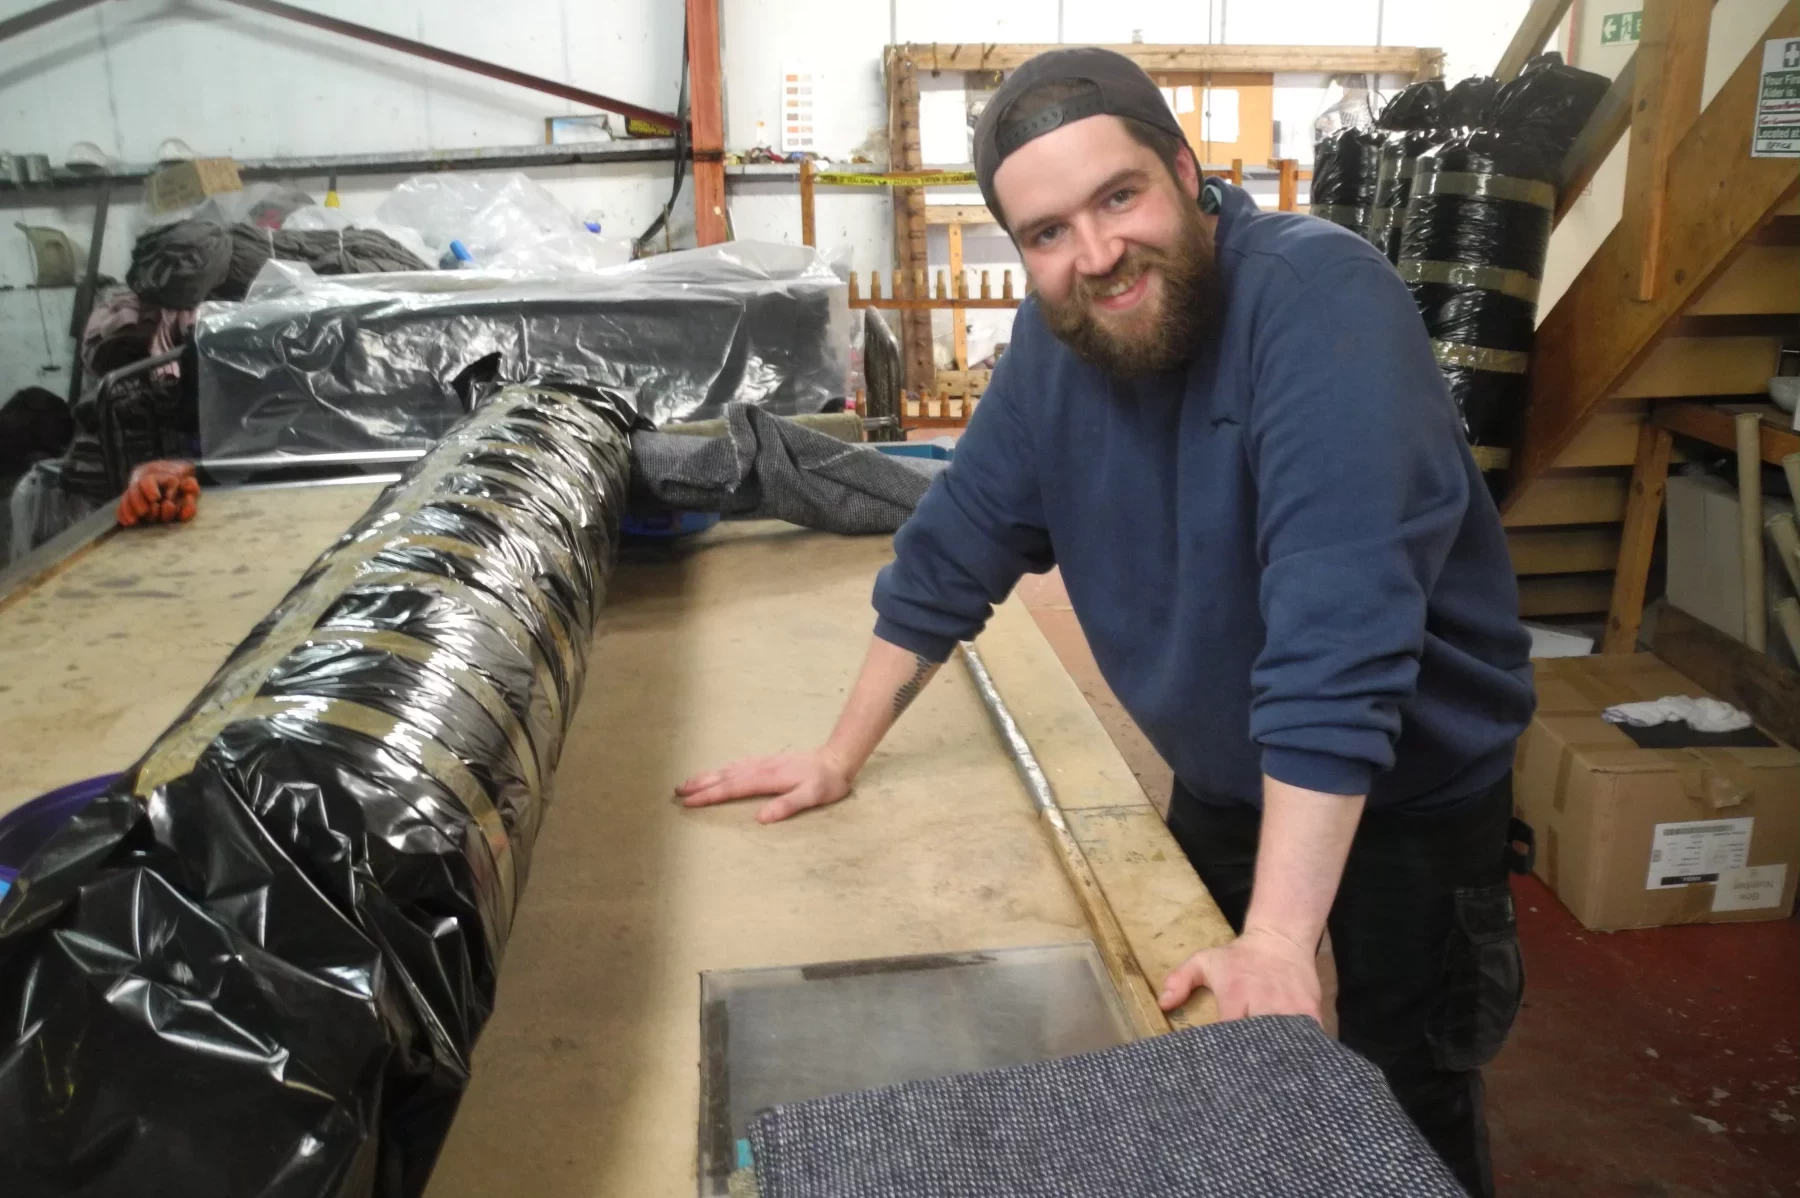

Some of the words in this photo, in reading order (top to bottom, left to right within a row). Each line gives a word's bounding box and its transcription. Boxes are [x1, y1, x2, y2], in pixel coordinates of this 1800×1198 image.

[1765, 75, 1784, 86] Your
[1763, 87, 1784, 98] Aider
[1758, 128, 1789, 139] Located
[1732, 880, 1774, 890] Number
